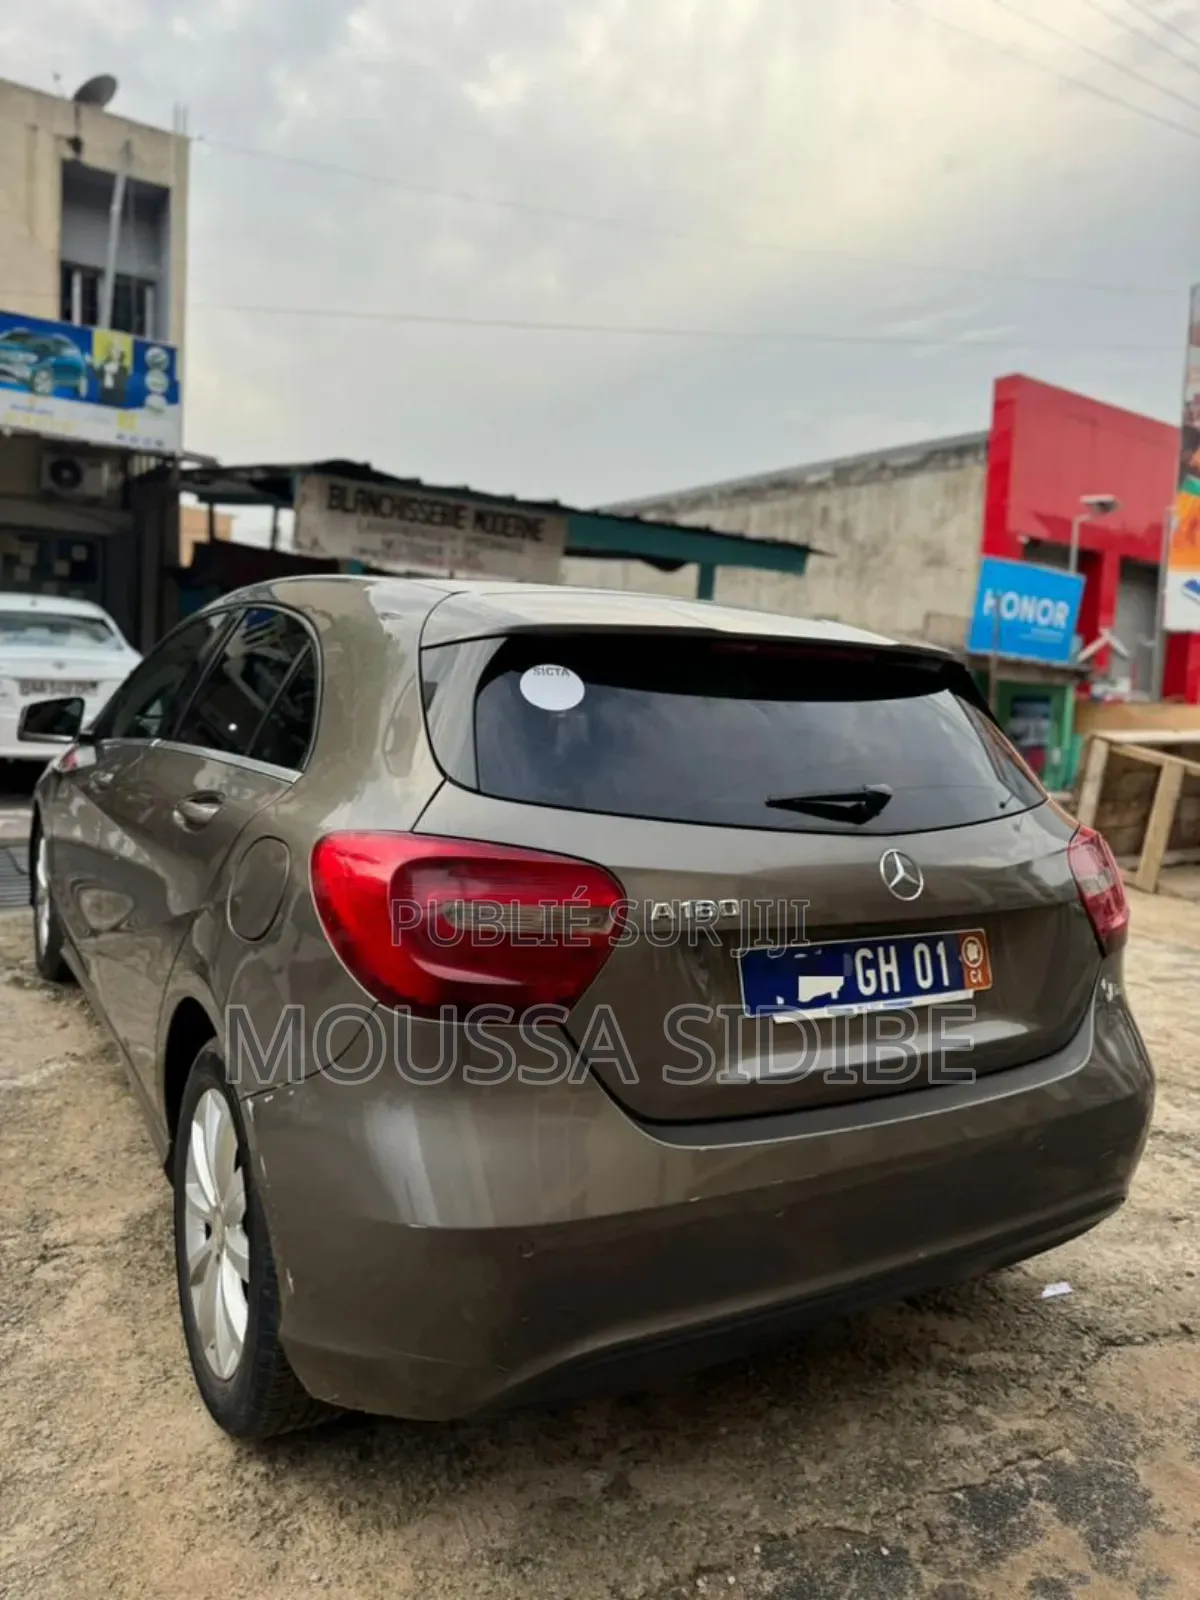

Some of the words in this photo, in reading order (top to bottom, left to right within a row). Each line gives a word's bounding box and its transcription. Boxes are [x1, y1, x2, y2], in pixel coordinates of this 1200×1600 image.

[327, 483, 469, 531] BLANCHISSERIE
[474, 510, 545, 542] MODERNE
[983, 588, 1070, 629] HONOR
[532, 666, 570, 677] SICTA
[855, 945, 900, 996] GH
[913, 940, 949, 989] 01
